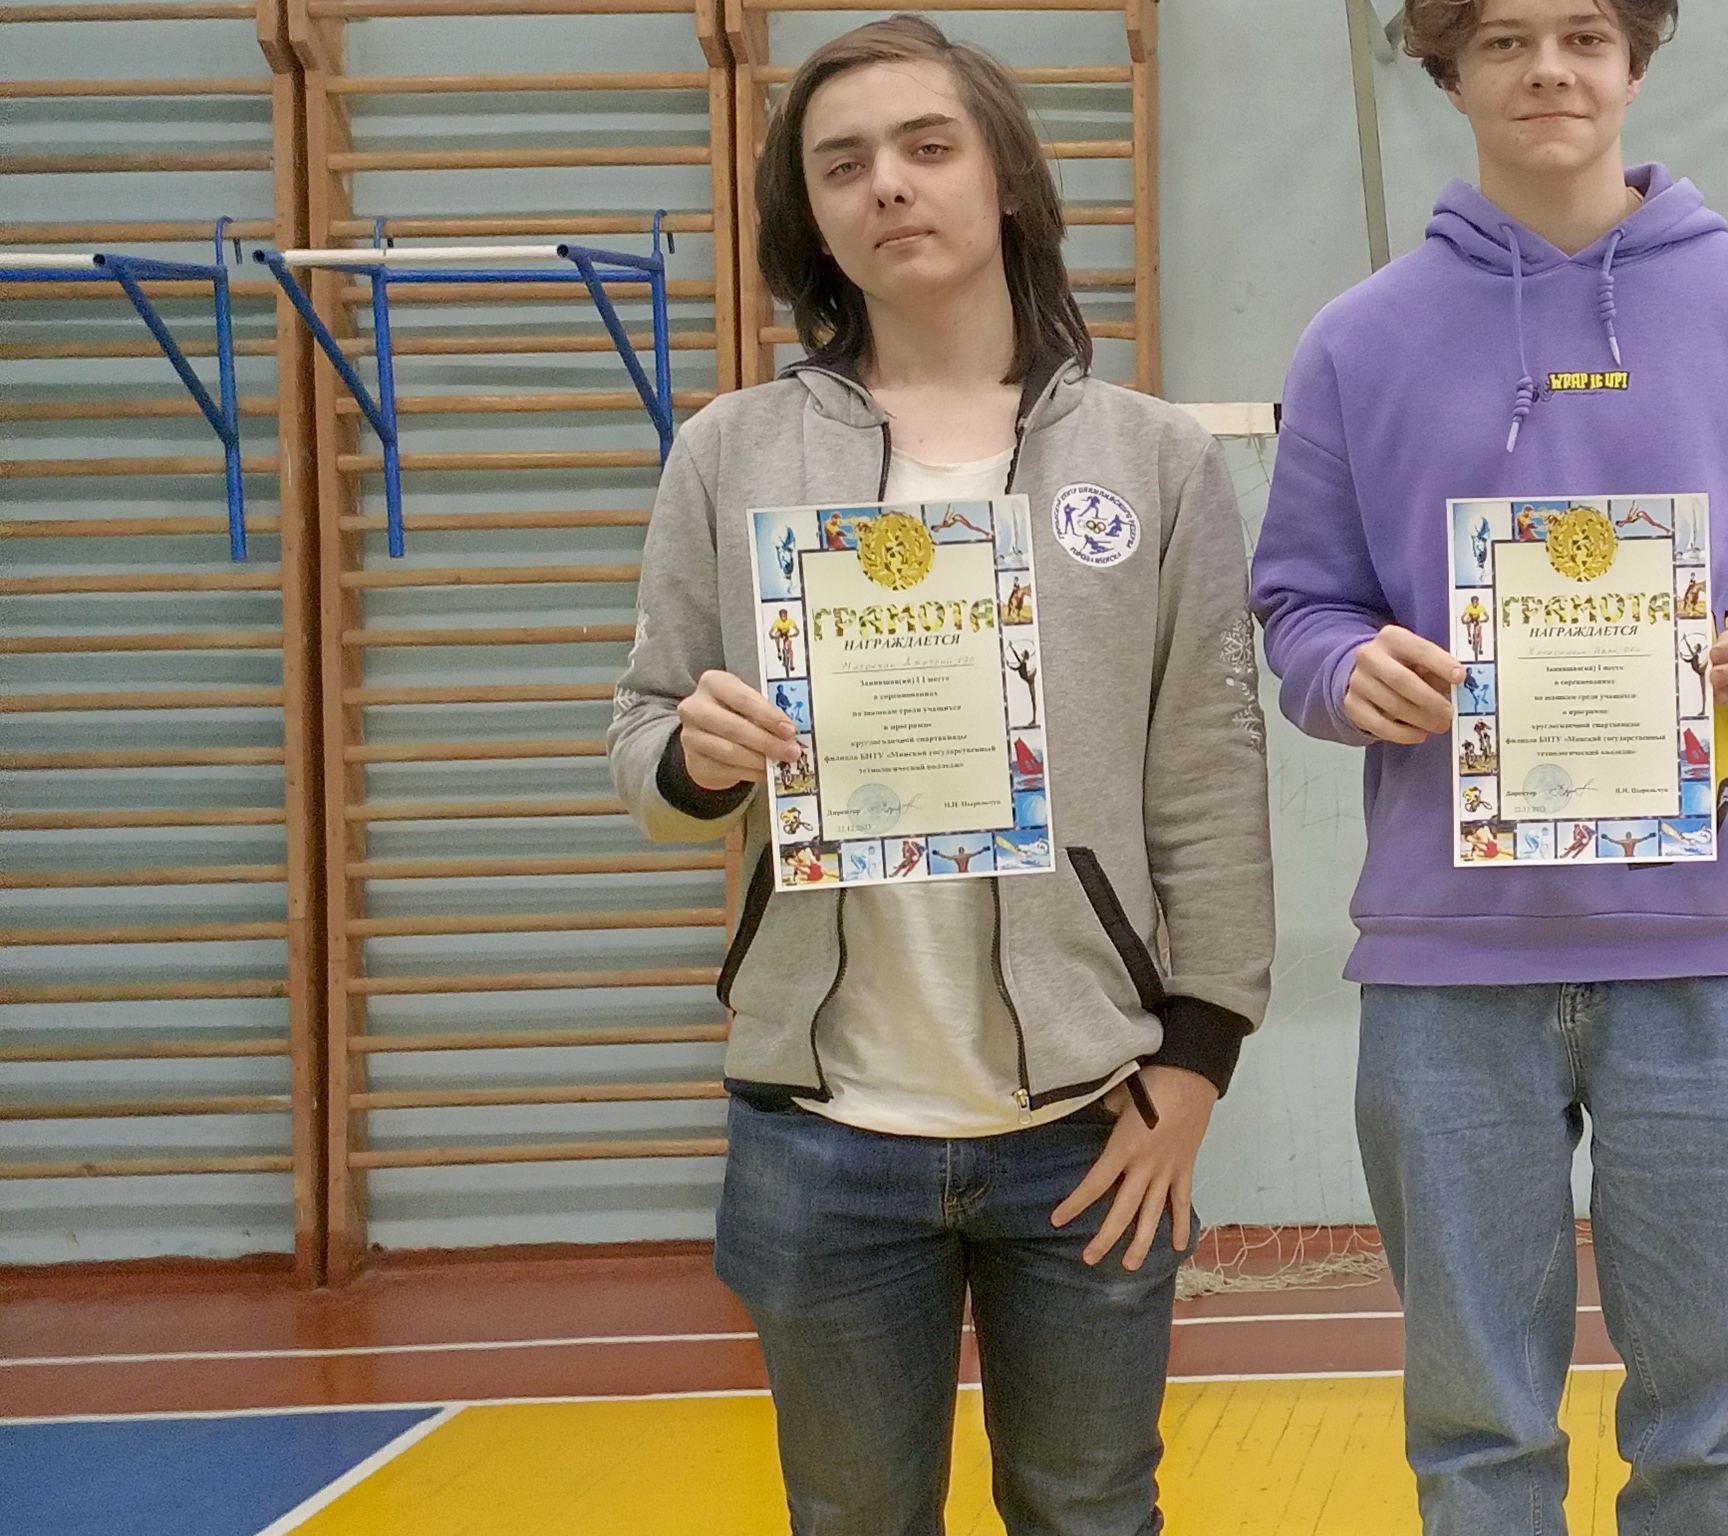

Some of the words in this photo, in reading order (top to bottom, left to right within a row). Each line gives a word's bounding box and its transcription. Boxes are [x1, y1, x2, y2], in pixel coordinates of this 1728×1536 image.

[1549, 372, 1588, 390] WRAP
[1604, 372, 1628, 388] UP!
[812, 597, 996, 641] ГРАМОТА
[1501, 592, 1671, 628] ГРАМОТА
[1529, 625, 1639, 638] НАГРАЖДАЕТСЯ
[843, 633, 962, 651] НАГРАЖДАЕТСЯ
